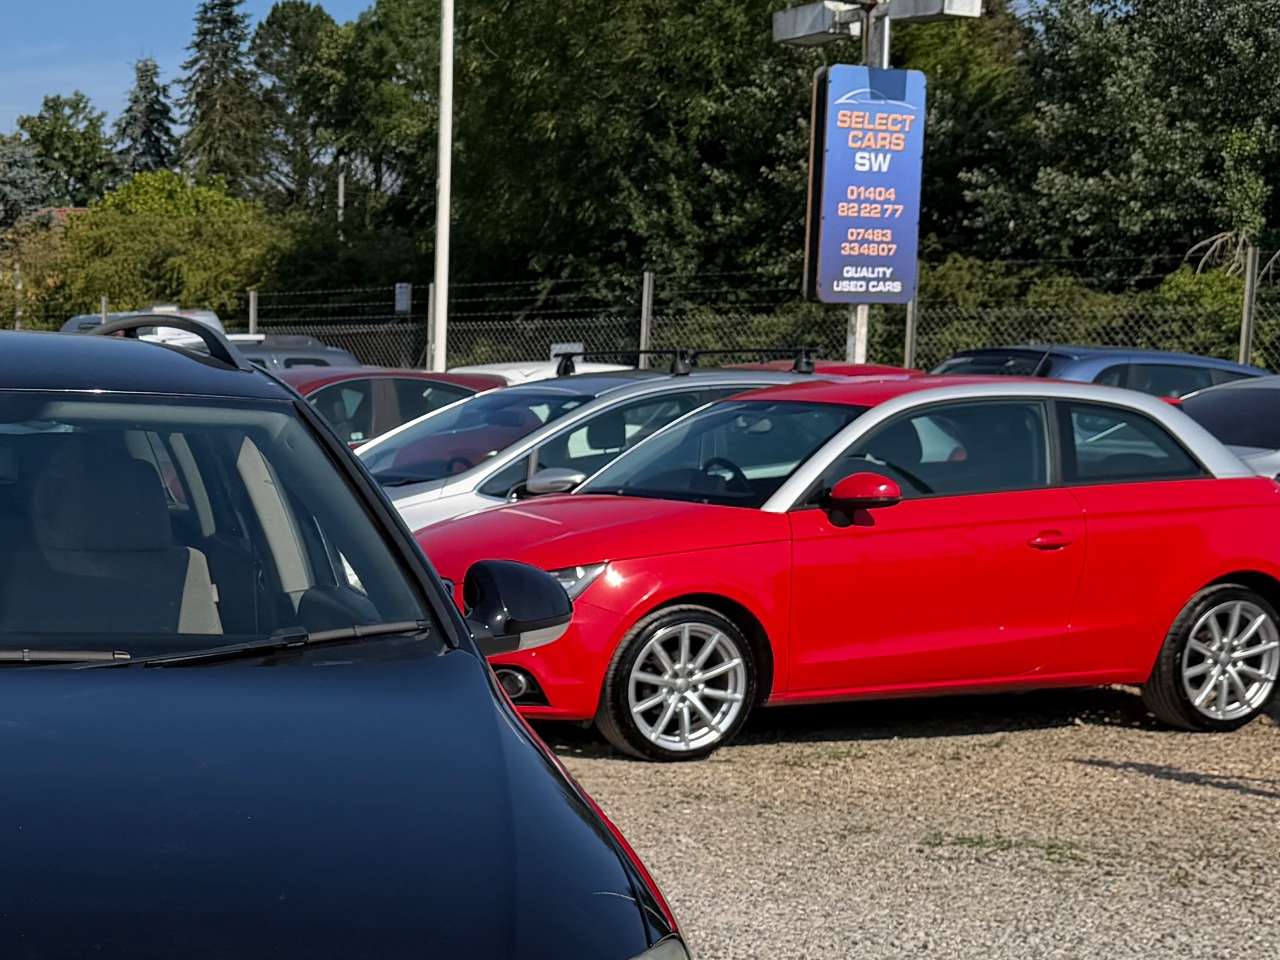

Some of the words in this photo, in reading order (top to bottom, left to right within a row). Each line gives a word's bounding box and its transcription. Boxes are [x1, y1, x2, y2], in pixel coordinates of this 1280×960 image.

[836, 110, 916, 132] SELECT
[848, 130, 906, 151] CARS
[854, 151, 892, 172] SW
[847, 185, 897, 201] 01404
[847, 228, 893, 241] 07483
[840, 242, 897, 256] 334807
[842, 265, 894, 279] QUALITY
[833, 280, 867, 292] USED
[868, 280, 902, 293] CARS
